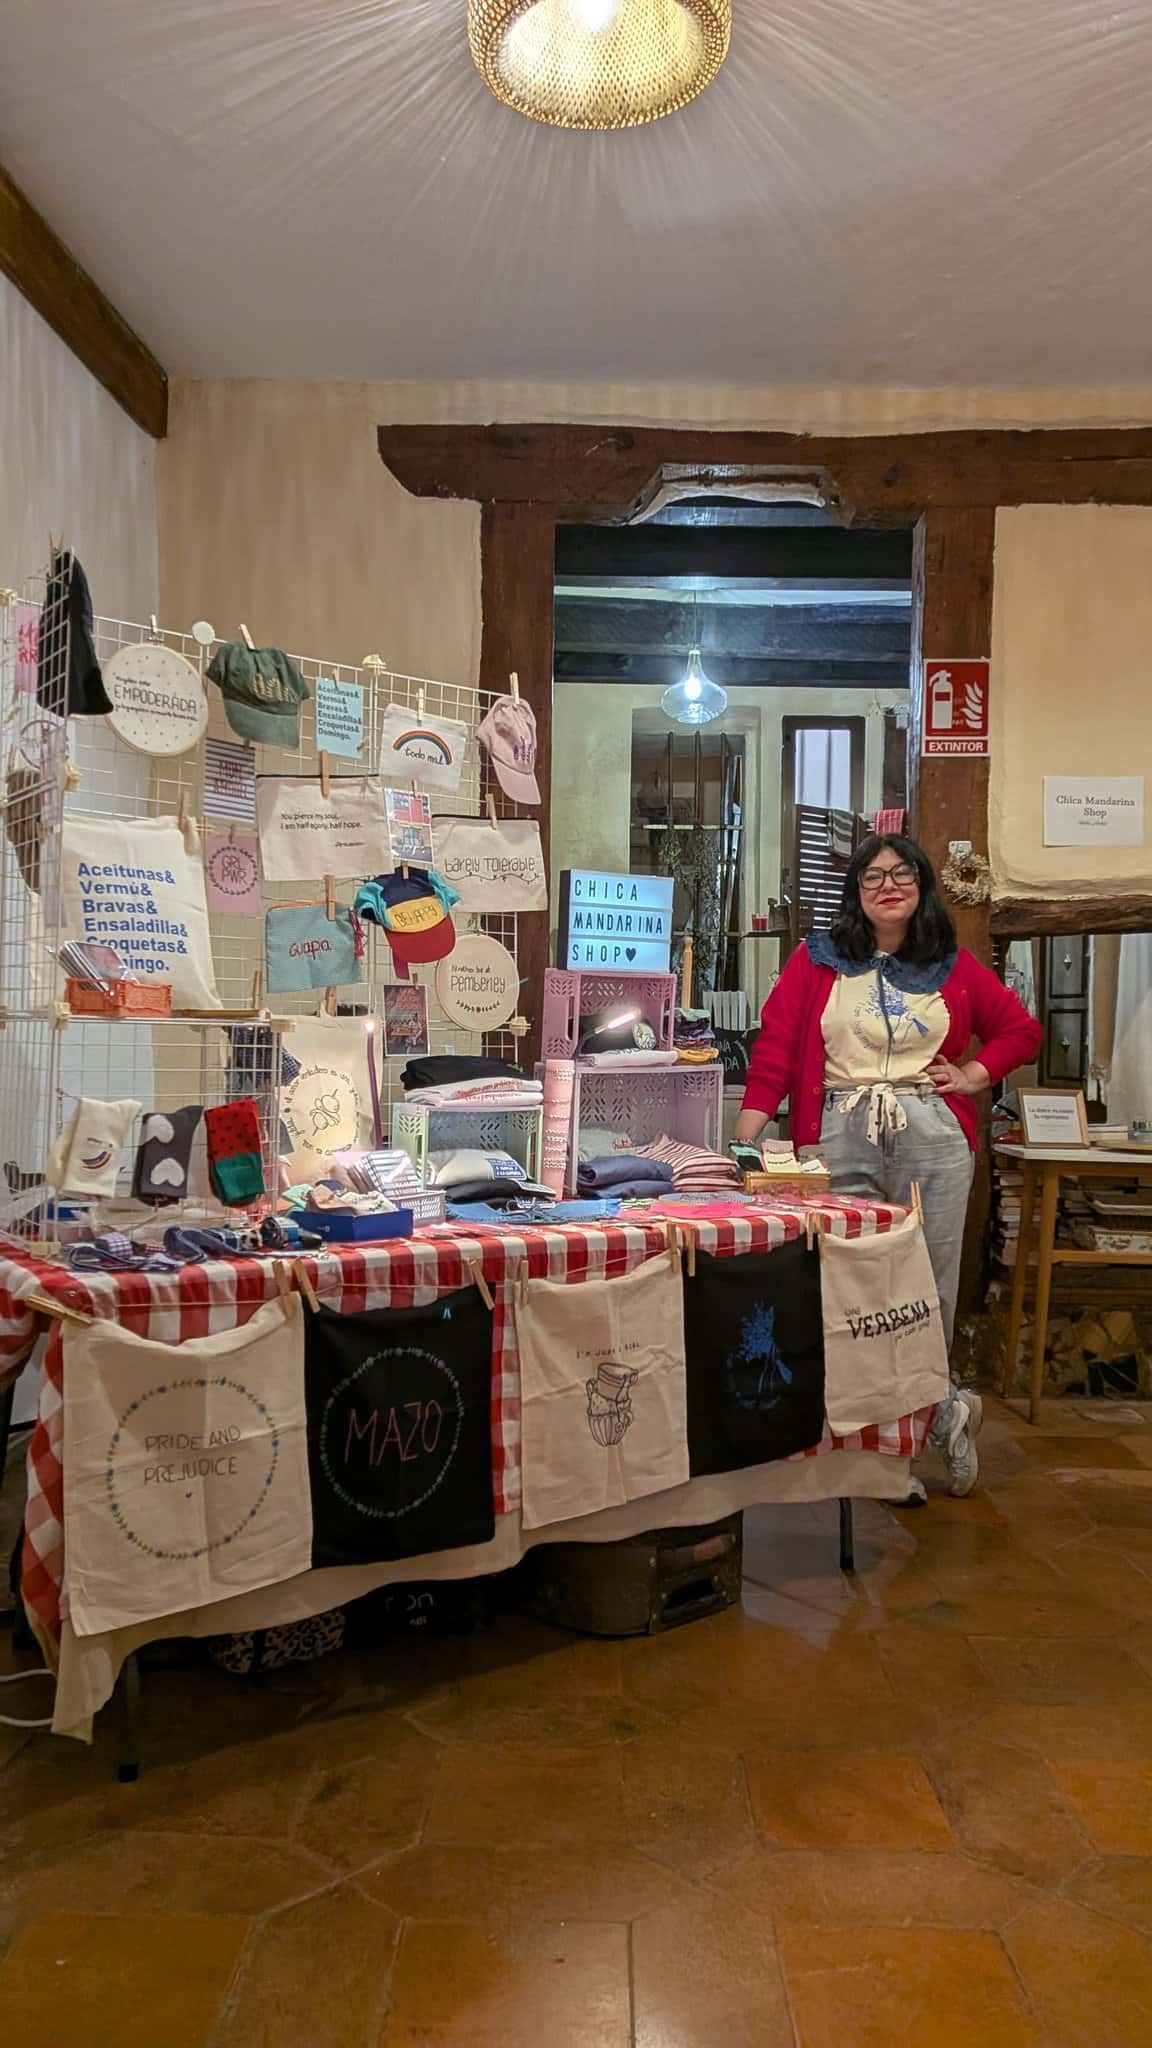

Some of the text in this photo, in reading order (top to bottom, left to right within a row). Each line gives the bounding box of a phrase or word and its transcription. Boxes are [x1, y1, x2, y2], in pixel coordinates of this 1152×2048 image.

[114, 684, 197, 714] EMPODERADA
[405, 745, 425, 760] todo
[929, 742, 984, 752] EXTINTOR
[1056, 795, 1135, 806] Chica Mandarina
[1083, 807, 1107, 819] Shop
[78, 862, 175, 884] Aceitunas&
[575, 879, 637, 901] CHICA
[82, 899, 157, 915] Bravas&
[84, 917, 189, 937] Ensaladilla&
[573, 911, 662, 934] MANDARINA
[847, 1299, 930, 1340] VERBENA
[145, 1425, 241, 1452] PRIDE AND
[344, 1399, 443, 1467] MAZO
[144, 1456, 239, 1486] PREJUDICE
